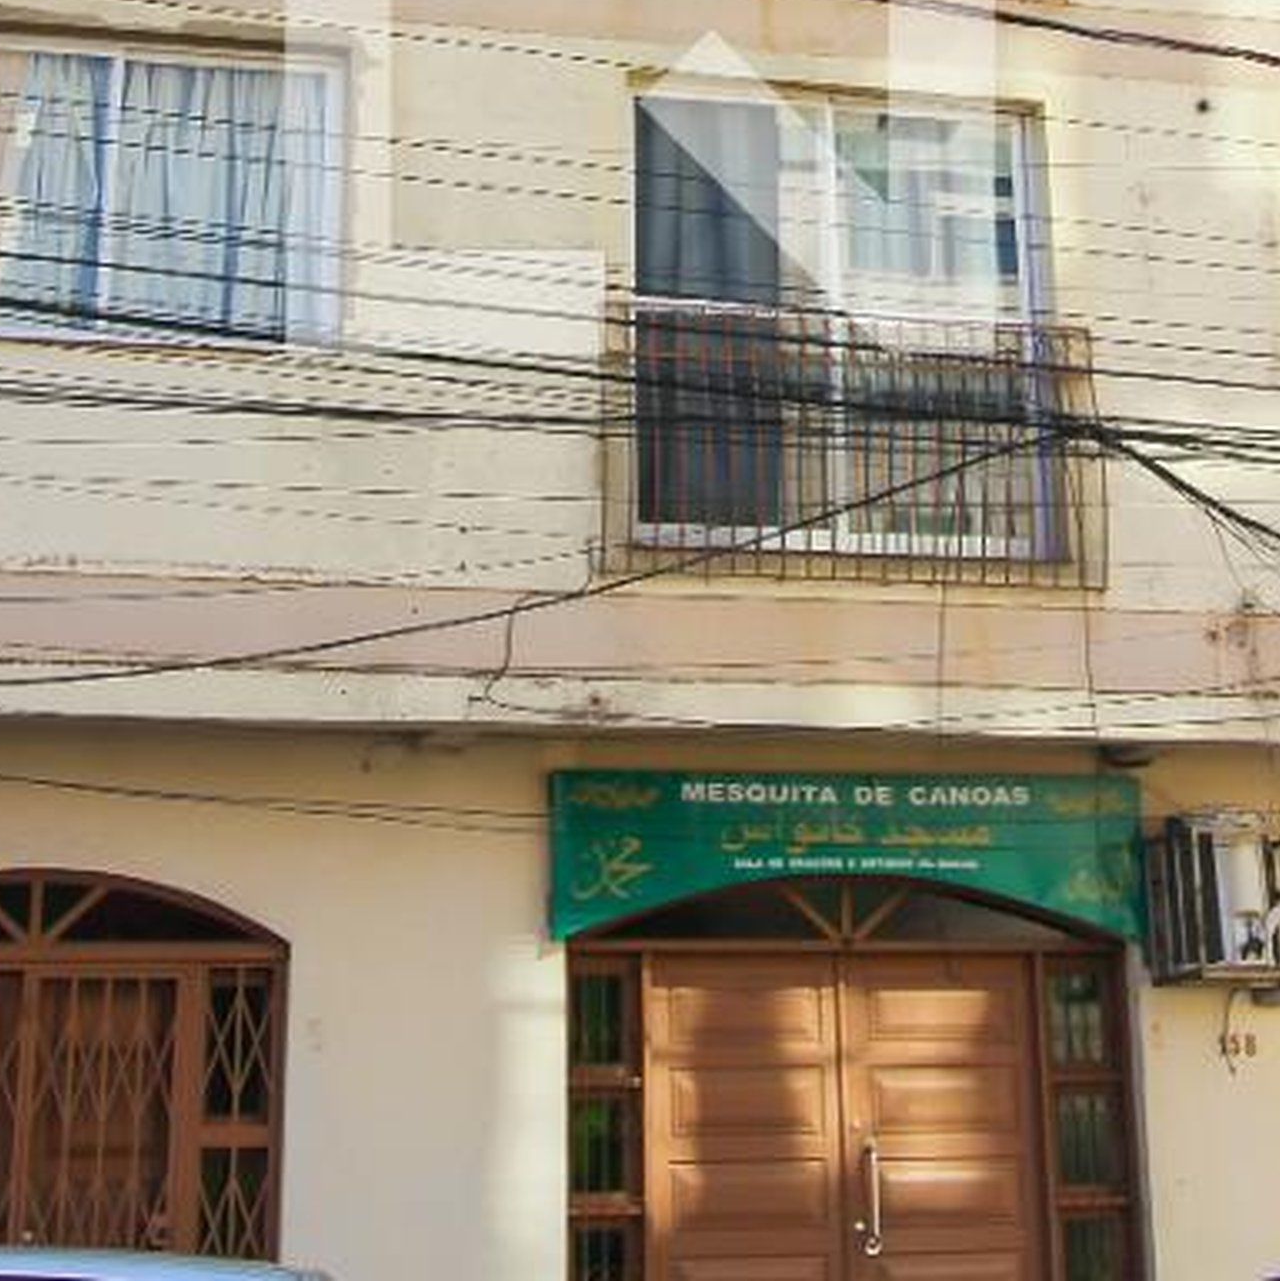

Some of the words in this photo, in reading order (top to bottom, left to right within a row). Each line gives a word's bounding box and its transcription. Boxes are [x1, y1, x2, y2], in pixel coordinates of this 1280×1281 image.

[681, 782, 839, 804] MESQUITA
[854, 786, 894, 806] DE
[908, 786, 1031, 807] CANOAS
